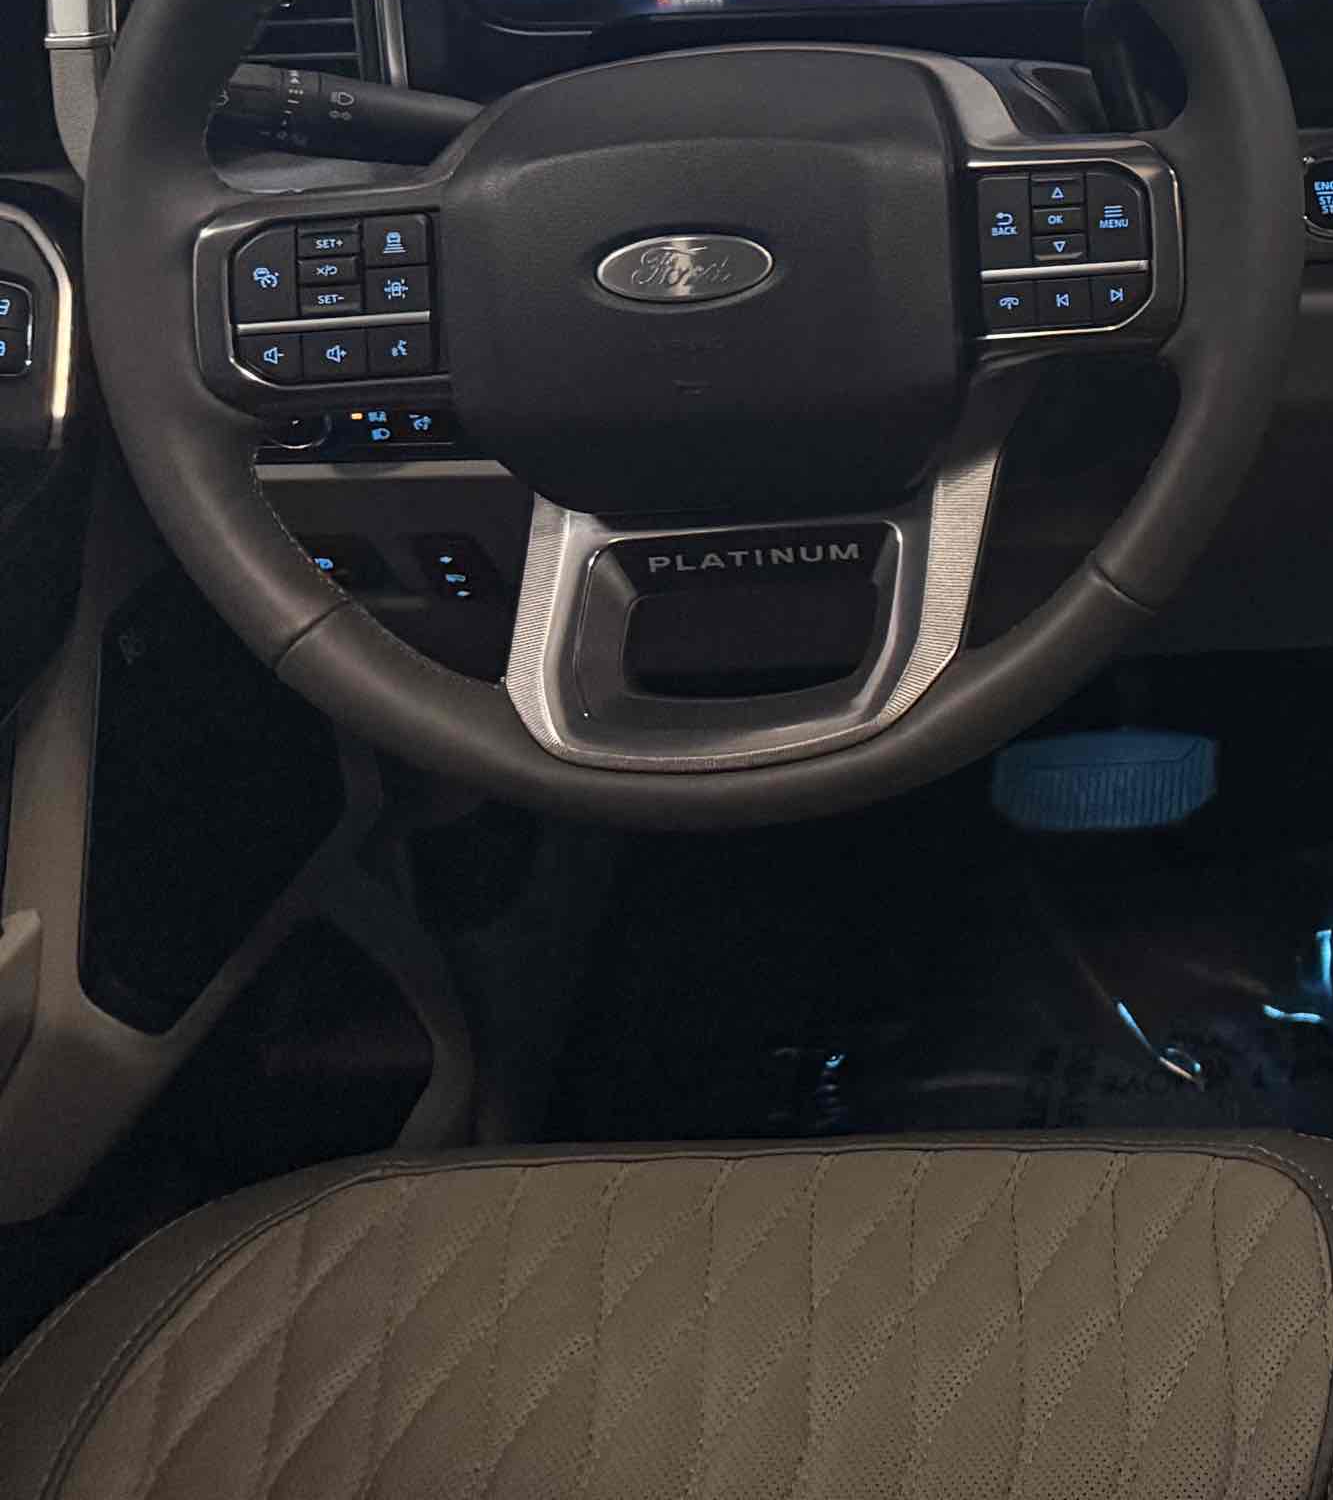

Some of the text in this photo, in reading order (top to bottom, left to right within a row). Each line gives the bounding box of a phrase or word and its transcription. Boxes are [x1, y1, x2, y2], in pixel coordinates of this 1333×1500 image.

[1047, 215, 1064, 225] OK
[1099, 218, 1129, 229] MENU
[991, 227, 1018, 237] BACK
[315, 238, 344, 249] SET+
[631, 246, 732, 285] Ford
[648, 543, 860, 573] PLATINUM
